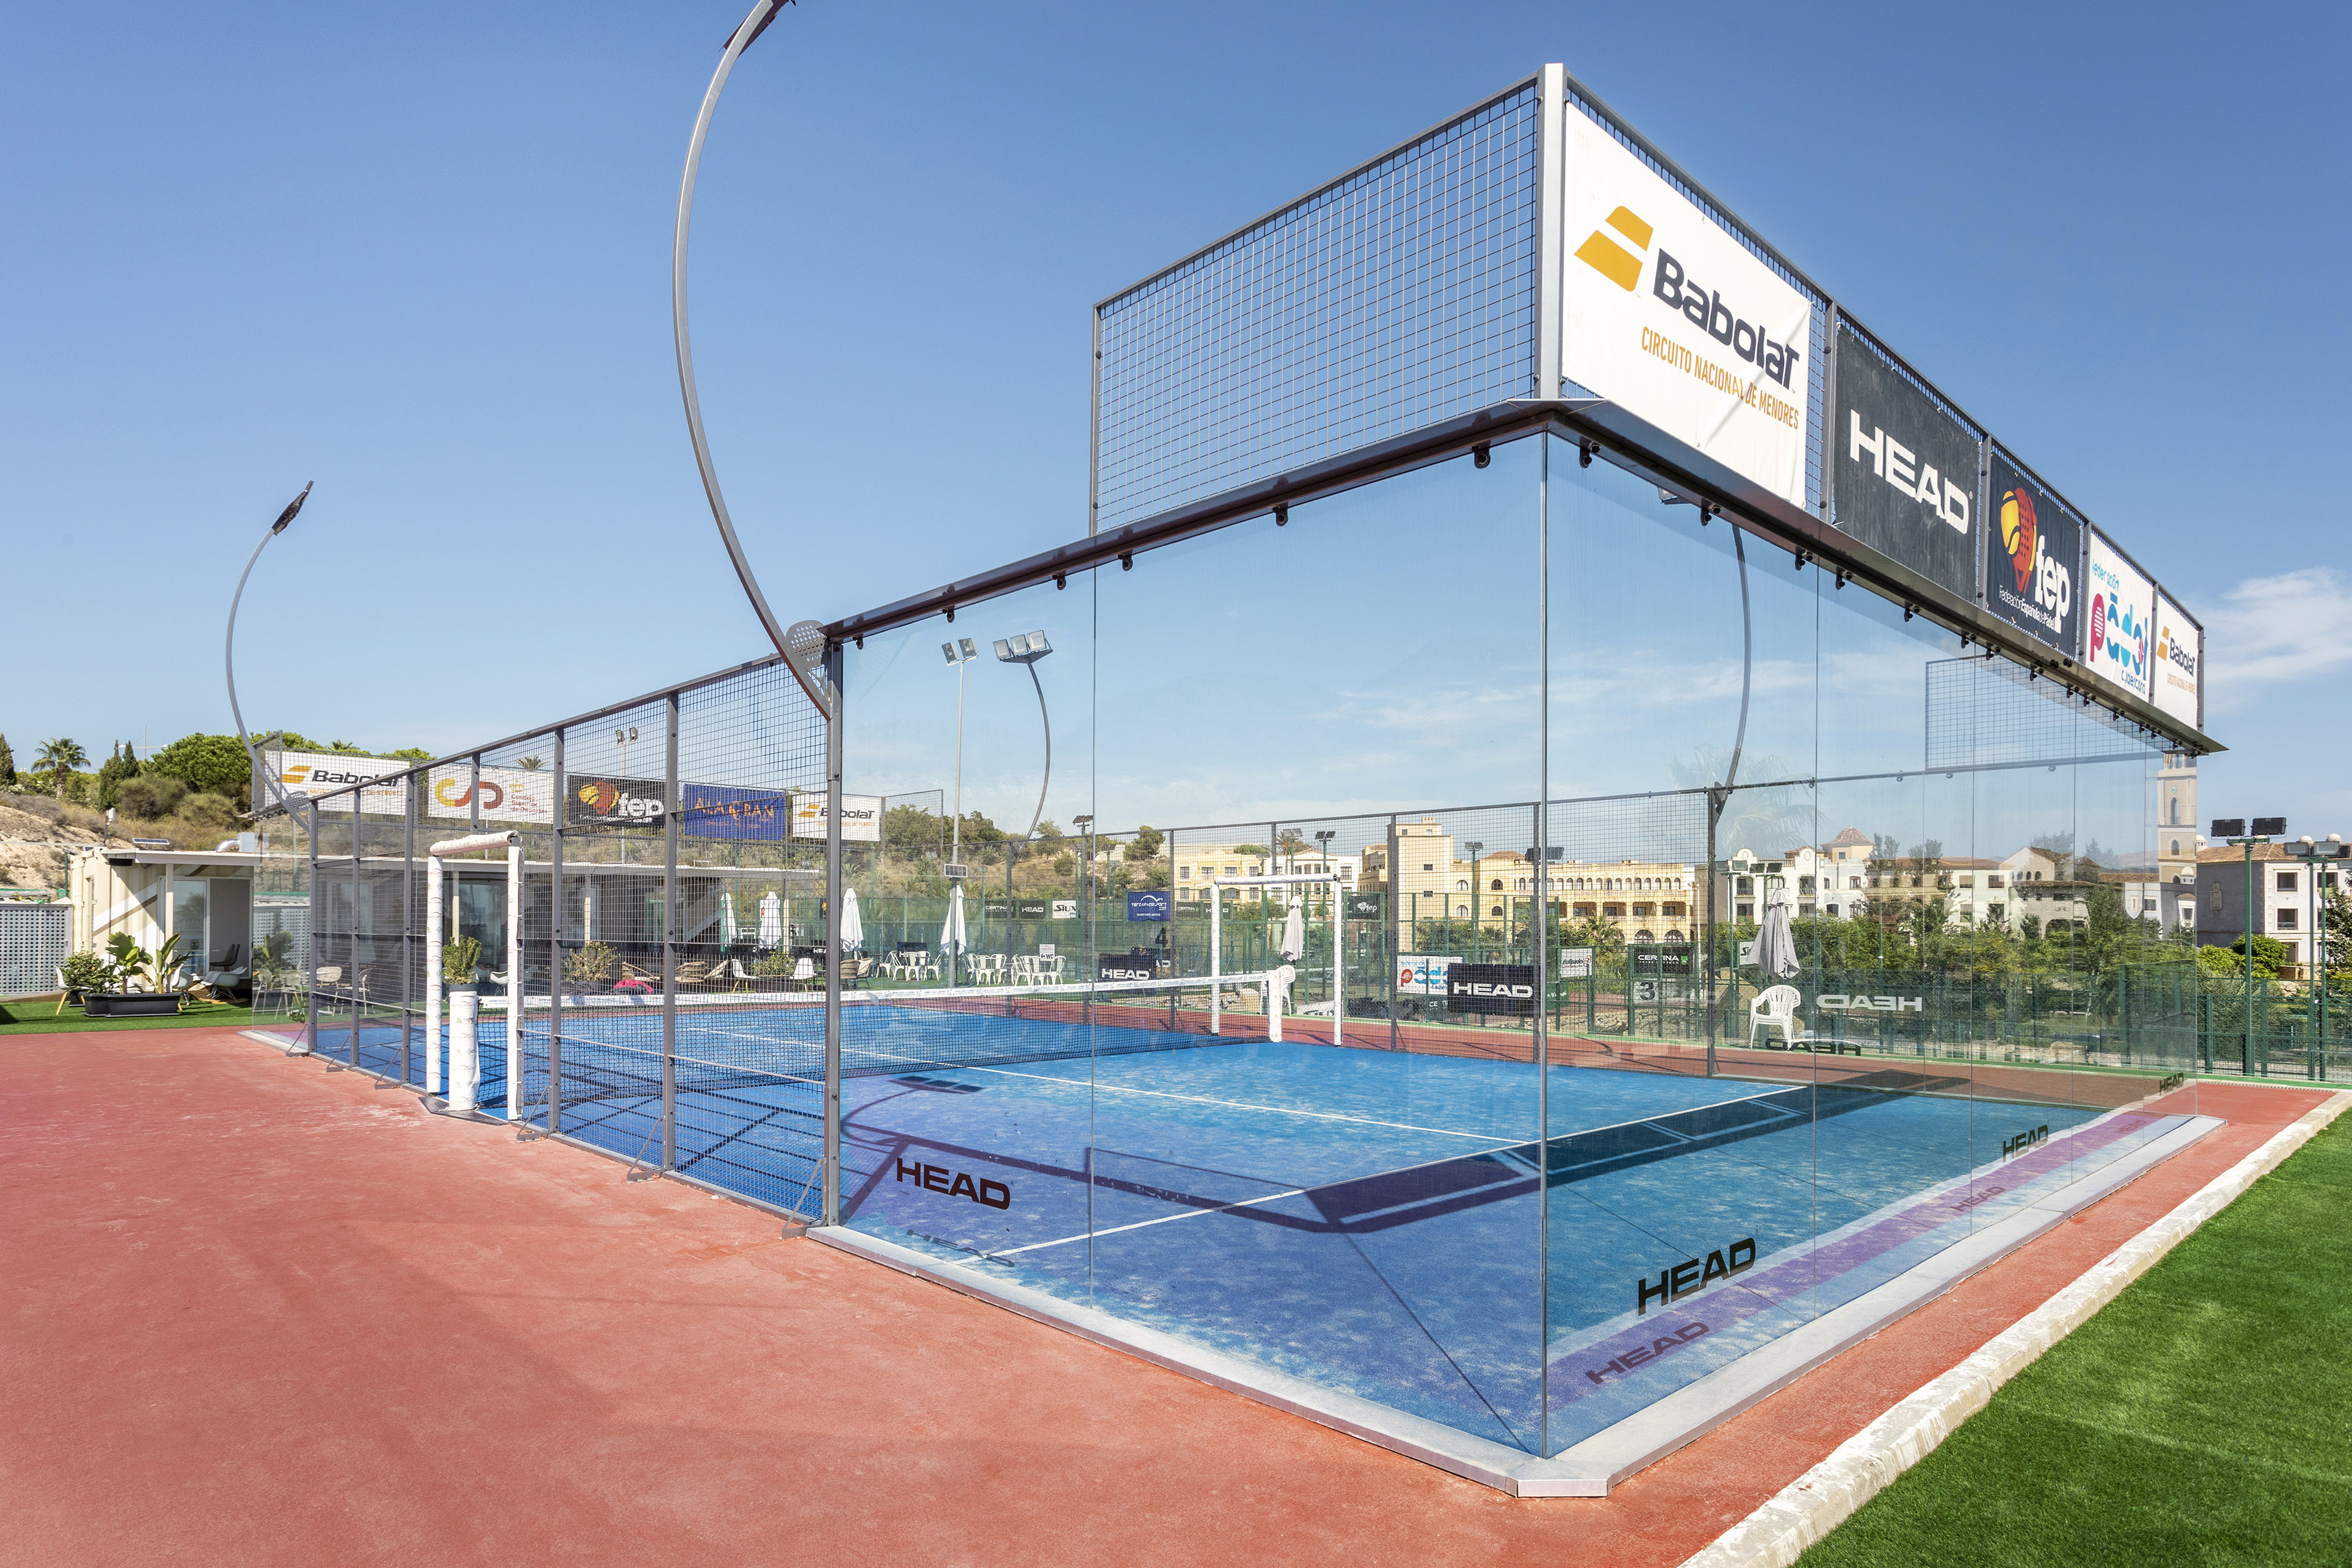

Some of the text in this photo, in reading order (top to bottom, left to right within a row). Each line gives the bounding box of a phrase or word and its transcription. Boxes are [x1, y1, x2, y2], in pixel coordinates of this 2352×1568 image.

[1642, 326, 1799, 430] CIRCUITO NACIONAL DE MENORES
[1849, 409, 1970, 534] HEAD
[2035, 535, 2071, 634] fep
[619, 793, 665, 823] fep
[820, 807, 875, 819] Bbolat
[1156, 927, 1168, 948] 4
[1102, 968, 1150, 980] HEAD
[1453, 982, 1533, 998] HEAD
[1639, 981, 1656, 1001] 3
[2159, 1072, 2184, 1096] HEAD
[2003, 1125, 2049, 1162] HEAD
[897, 1157, 1010, 1210] HEAD
[1638, 1237, 1756, 1316] HEAD
